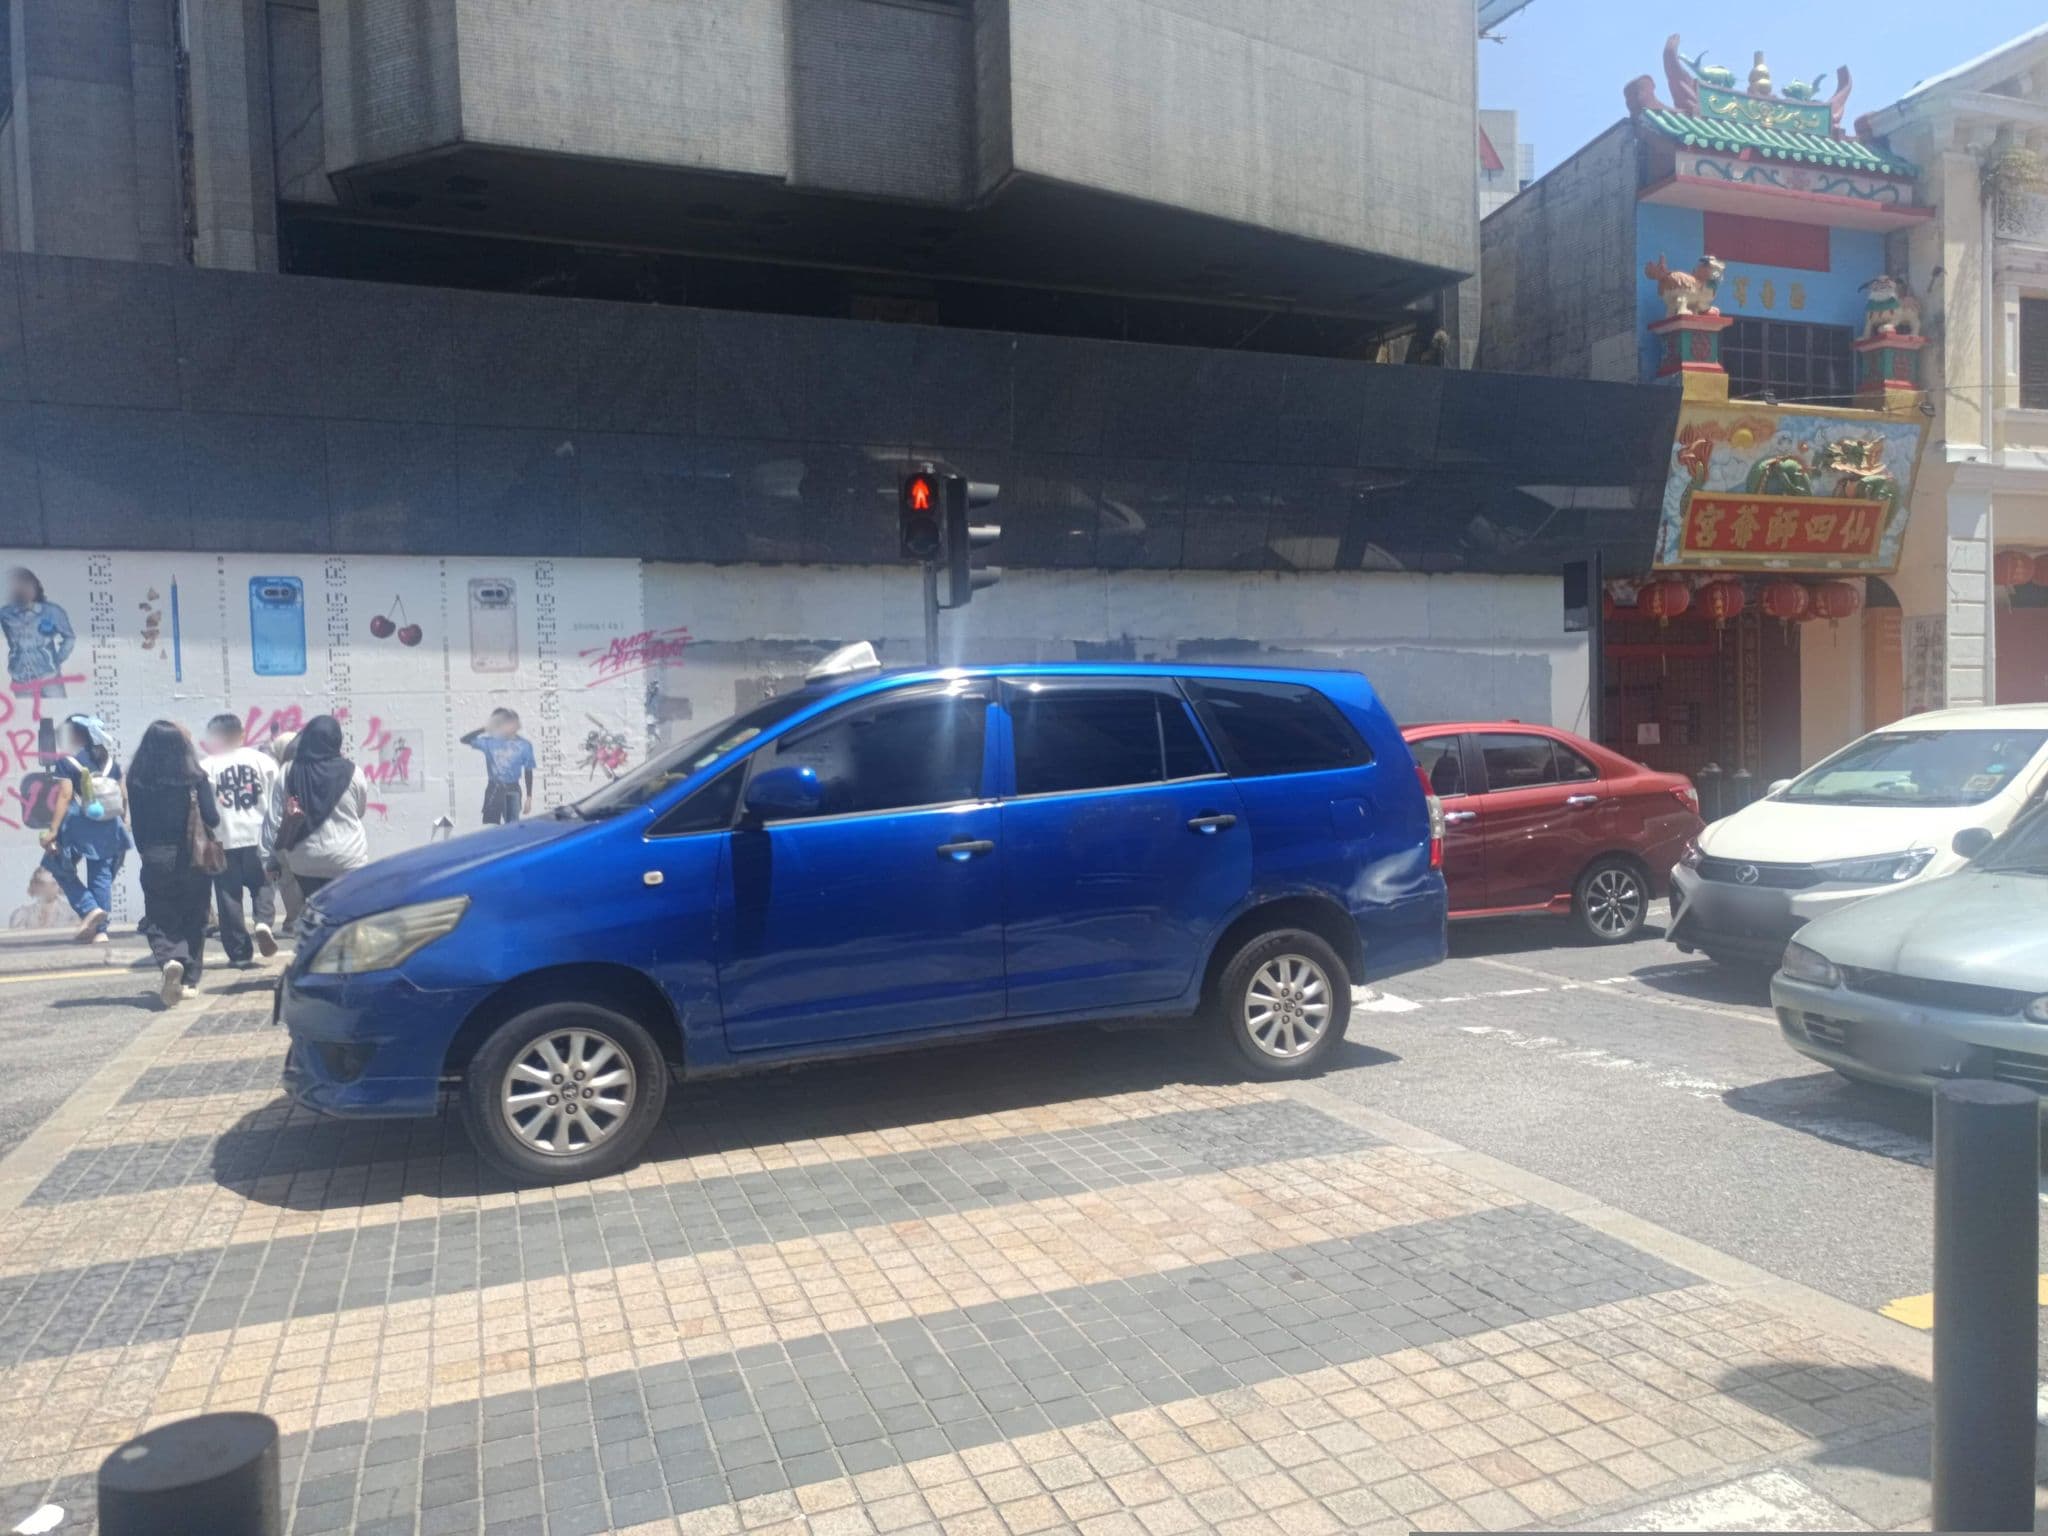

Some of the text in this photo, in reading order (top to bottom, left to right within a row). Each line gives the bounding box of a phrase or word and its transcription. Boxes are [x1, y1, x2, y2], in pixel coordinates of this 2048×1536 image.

[90, 591, 118, 695] NOTHING
[327, 592, 352, 691] NOTHING
[536, 593, 559, 688] NOTHING
[216, 764, 261, 788] NEVER
[218, 784, 263, 811] STOP
